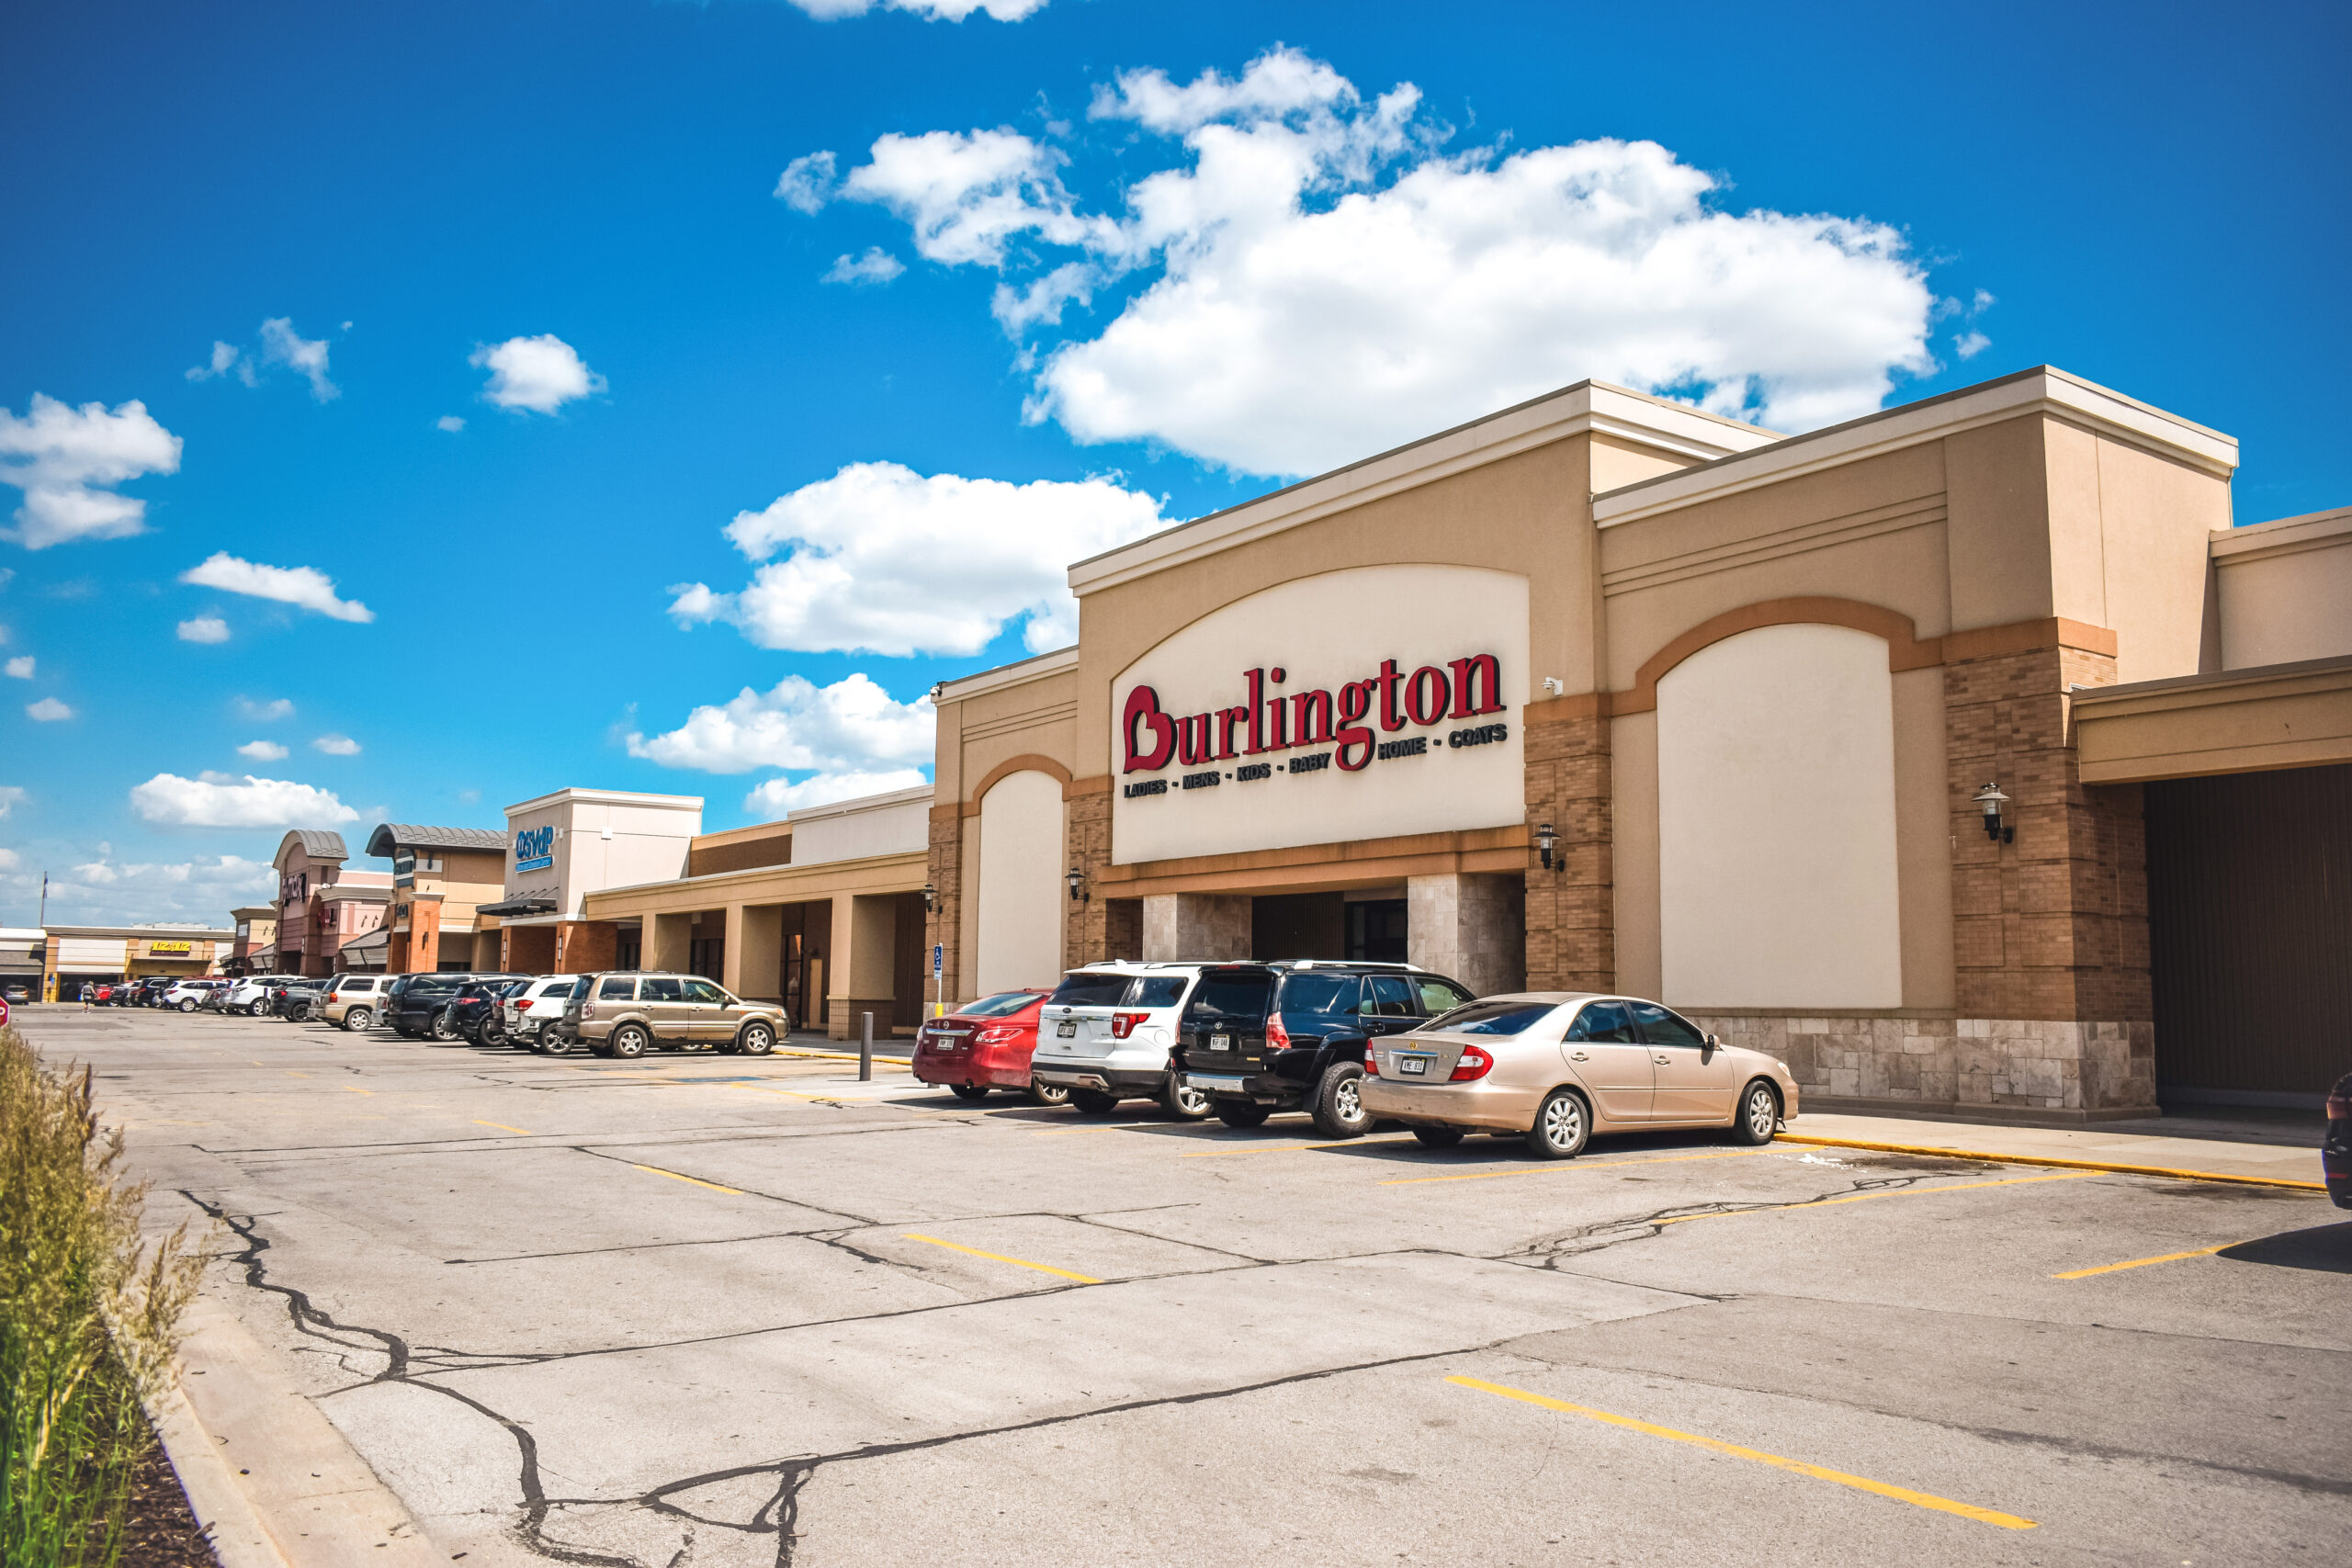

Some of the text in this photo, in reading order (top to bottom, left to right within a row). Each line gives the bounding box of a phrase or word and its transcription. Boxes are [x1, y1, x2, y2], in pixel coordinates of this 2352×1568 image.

[1123, 654, 1507, 774] Burlington
[1125, 724, 1508, 798] LADIES MENS KIDS BABY HOME COATS
